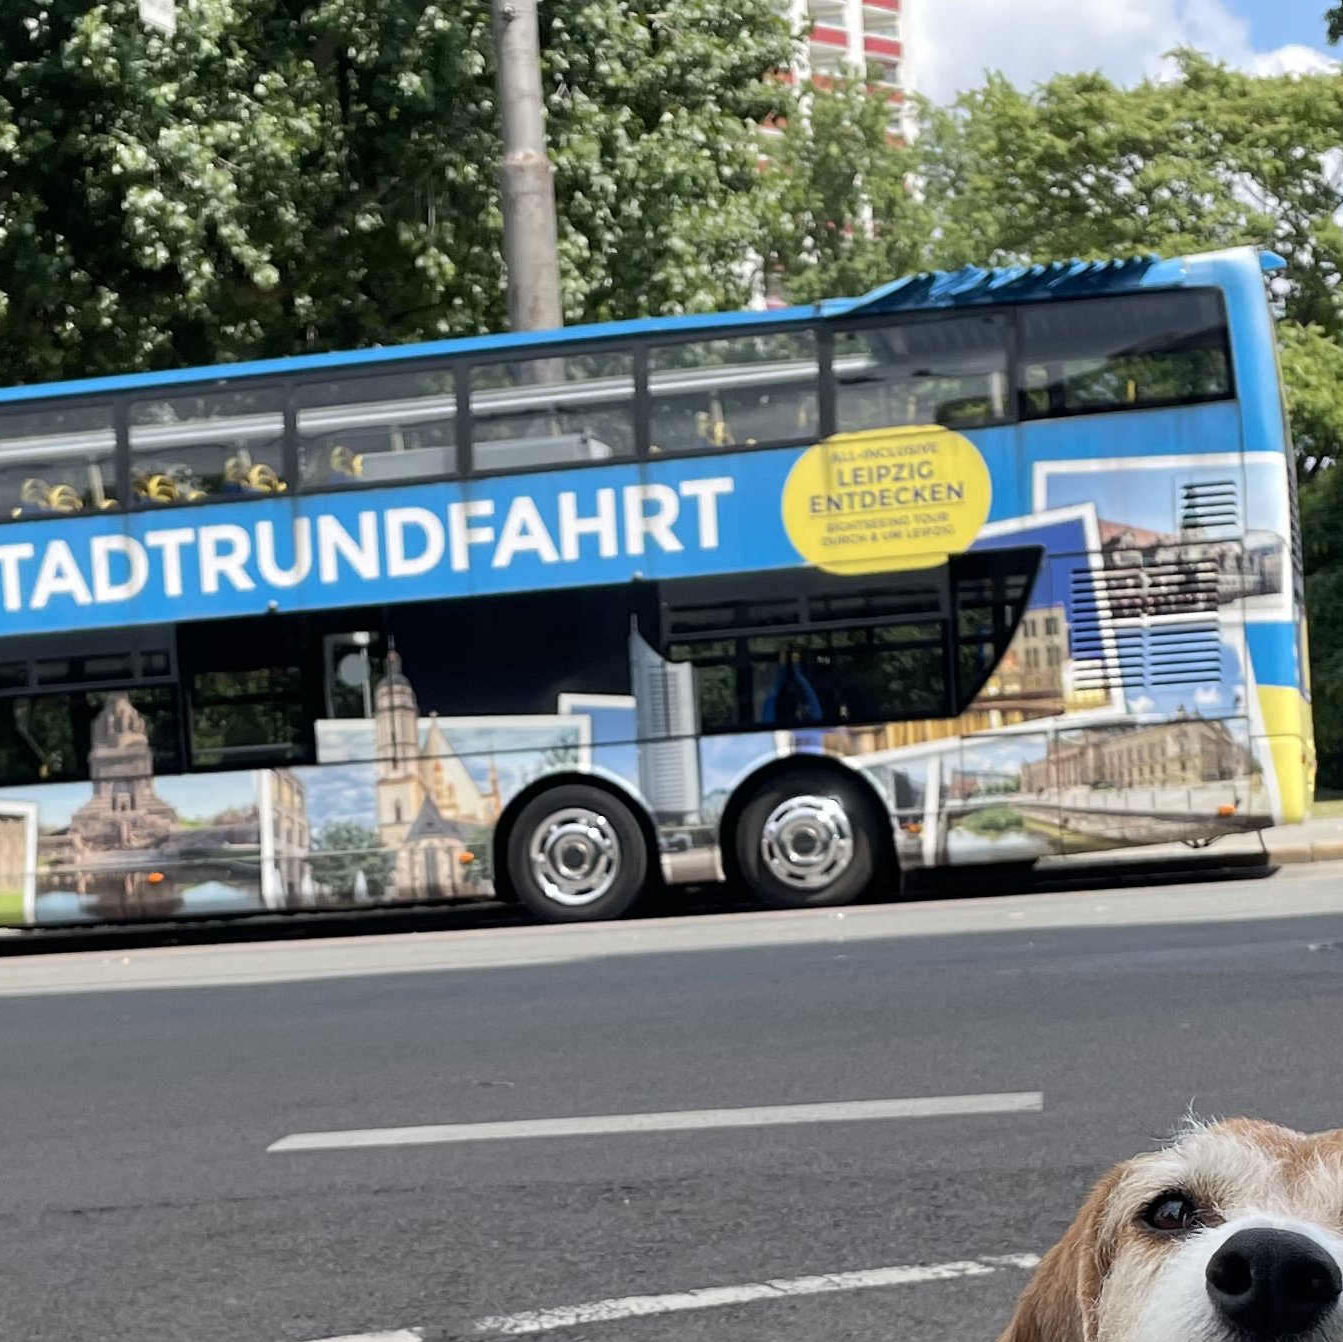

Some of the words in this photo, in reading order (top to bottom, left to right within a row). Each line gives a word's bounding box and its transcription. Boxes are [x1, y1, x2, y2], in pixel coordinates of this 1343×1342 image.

[831, 442, 938, 462] ALL-INCLUSIVE
[836, 460, 935, 488] LEIPZIG
[810, 482, 963, 513] ENTDECKEN
[906, 523, 956, 540] LEIPZIG
